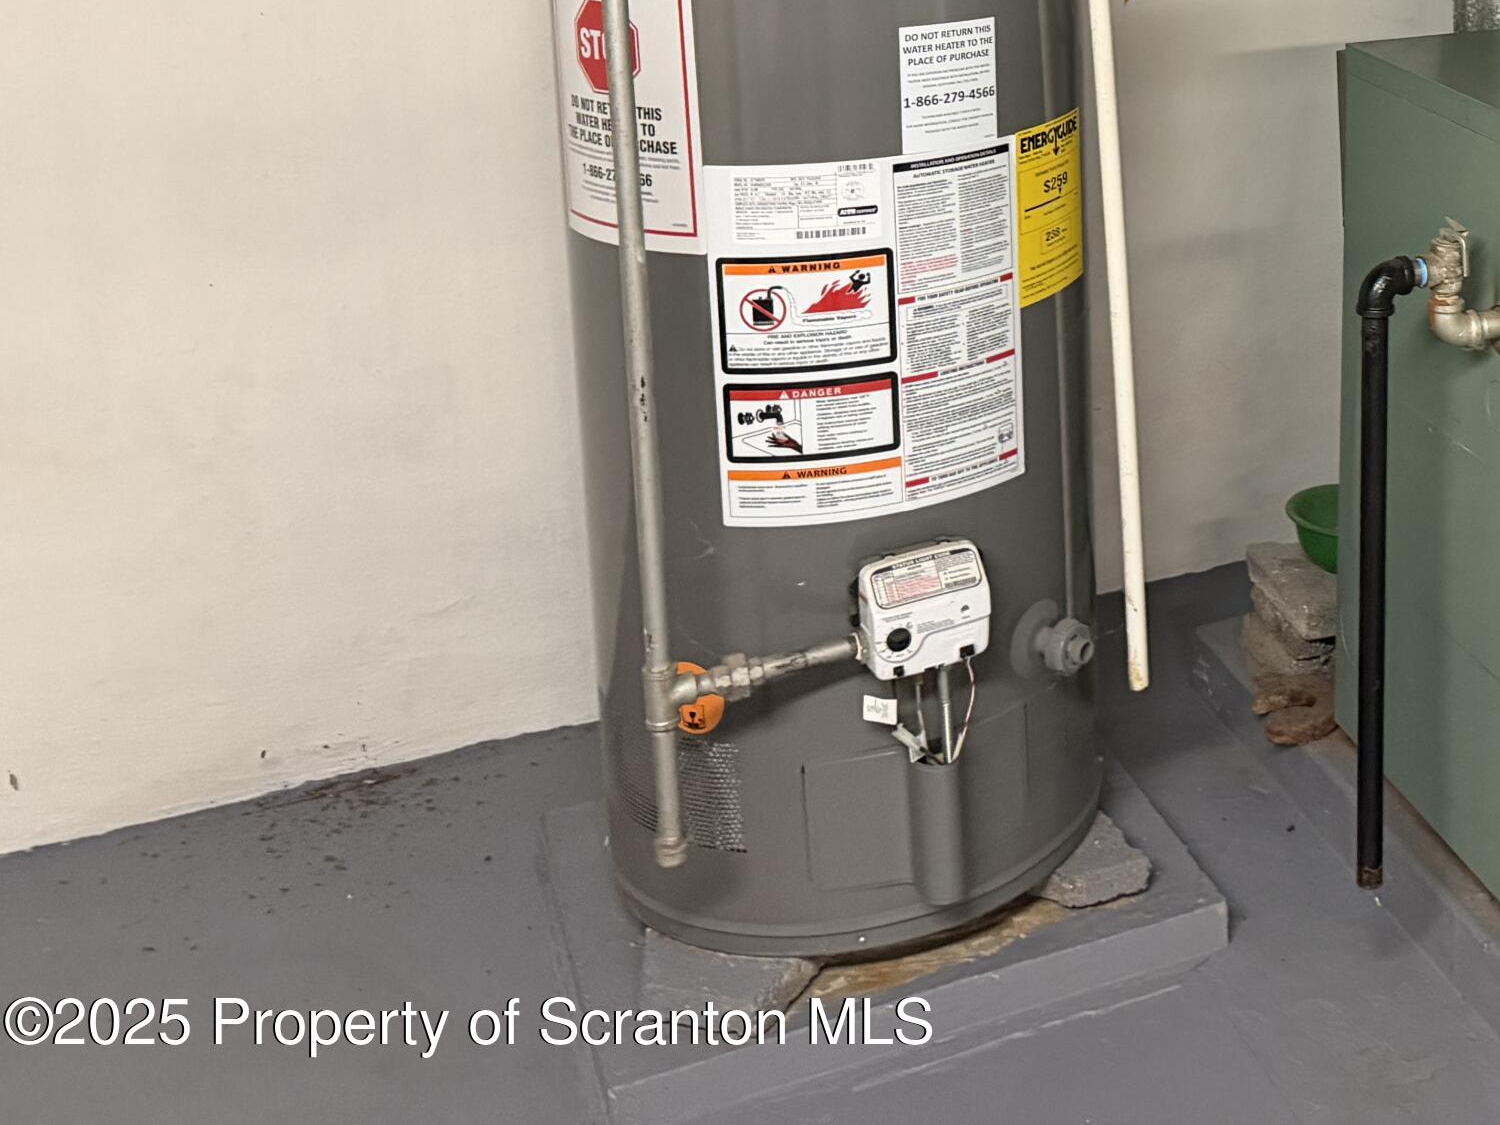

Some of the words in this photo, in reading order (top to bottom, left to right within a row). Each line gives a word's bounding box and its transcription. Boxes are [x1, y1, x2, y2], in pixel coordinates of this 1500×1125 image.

[905, 34, 918, 42] DO
[921, 32, 938, 40] NOT
[941, 27, 973, 38] RETURN
[975, 25, 991, 33] THIS
[580, 27, 606, 60] ST
[903, 44, 933, 54] WATER
[935, 41, 965, 51] HEATER
[968, 38, 978, 47] TO
[980, 36, 993, 44] THE
[908, 56, 934, 66] PLACE
[936, 55, 947, 63] OF
[950, 49, 990, 61] PURCHASE
[904, 85, 995, 109] 1-866-279-4566
[580, 97, 594, 111] NOT
[636, 107, 662, 121] THIS
[640, 123, 656, 136] TO
[580, 128, 602, 146] PLACE
[639, 140, 678, 155] CHASE
[781, 262, 841, 273] WARNING
[792, 387, 842, 398] DANGER
[797, 467, 848, 479] WARNING
